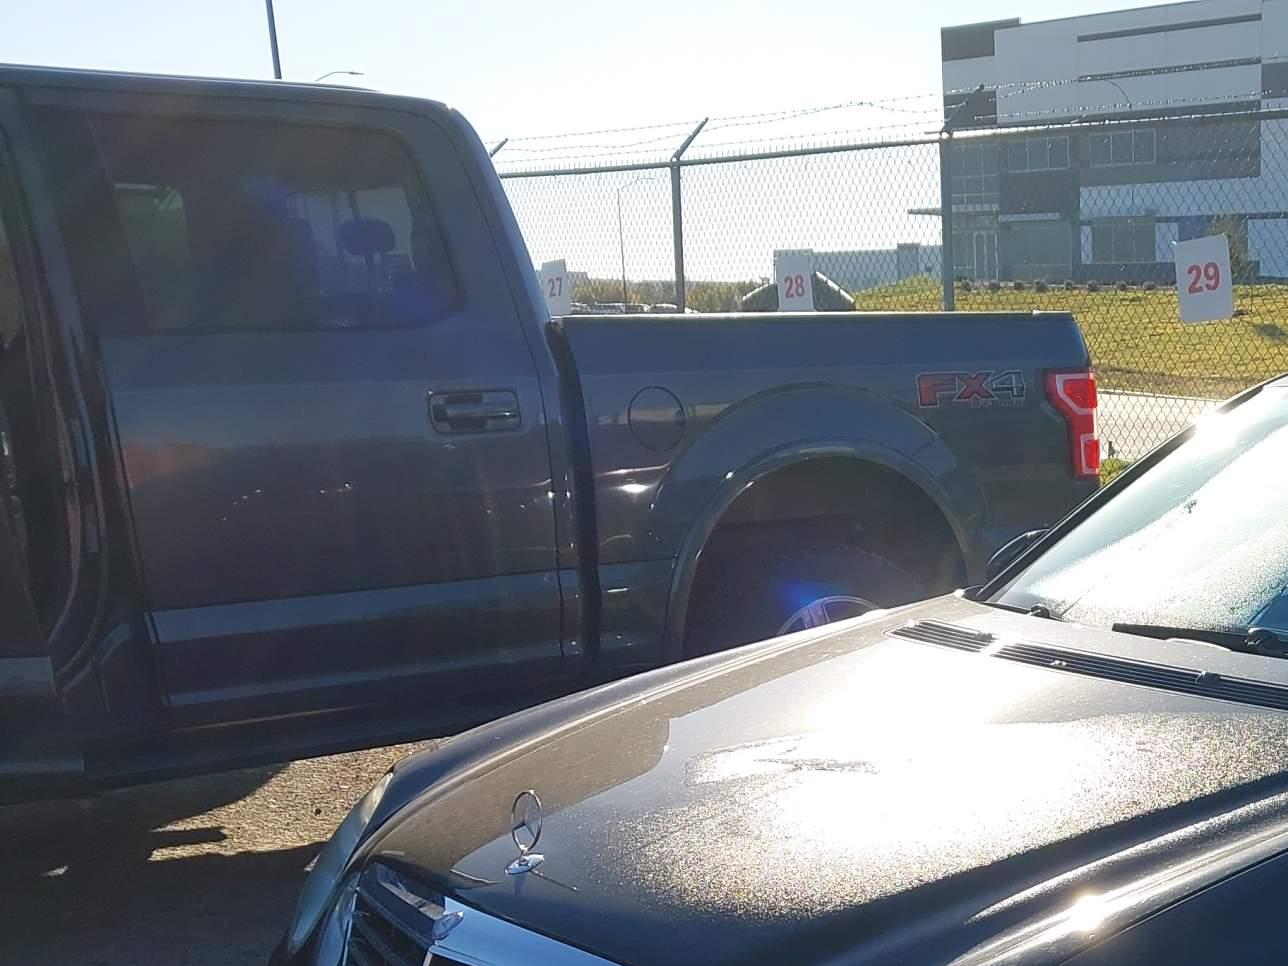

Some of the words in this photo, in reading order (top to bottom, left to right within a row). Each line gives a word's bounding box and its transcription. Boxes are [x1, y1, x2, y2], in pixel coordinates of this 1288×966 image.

[548, 277, 562, 297] 27
[784, 275, 805, 298] 28
[1187, 262, 1220, 294] 29
[915, 369, 1025, 408] FX4
